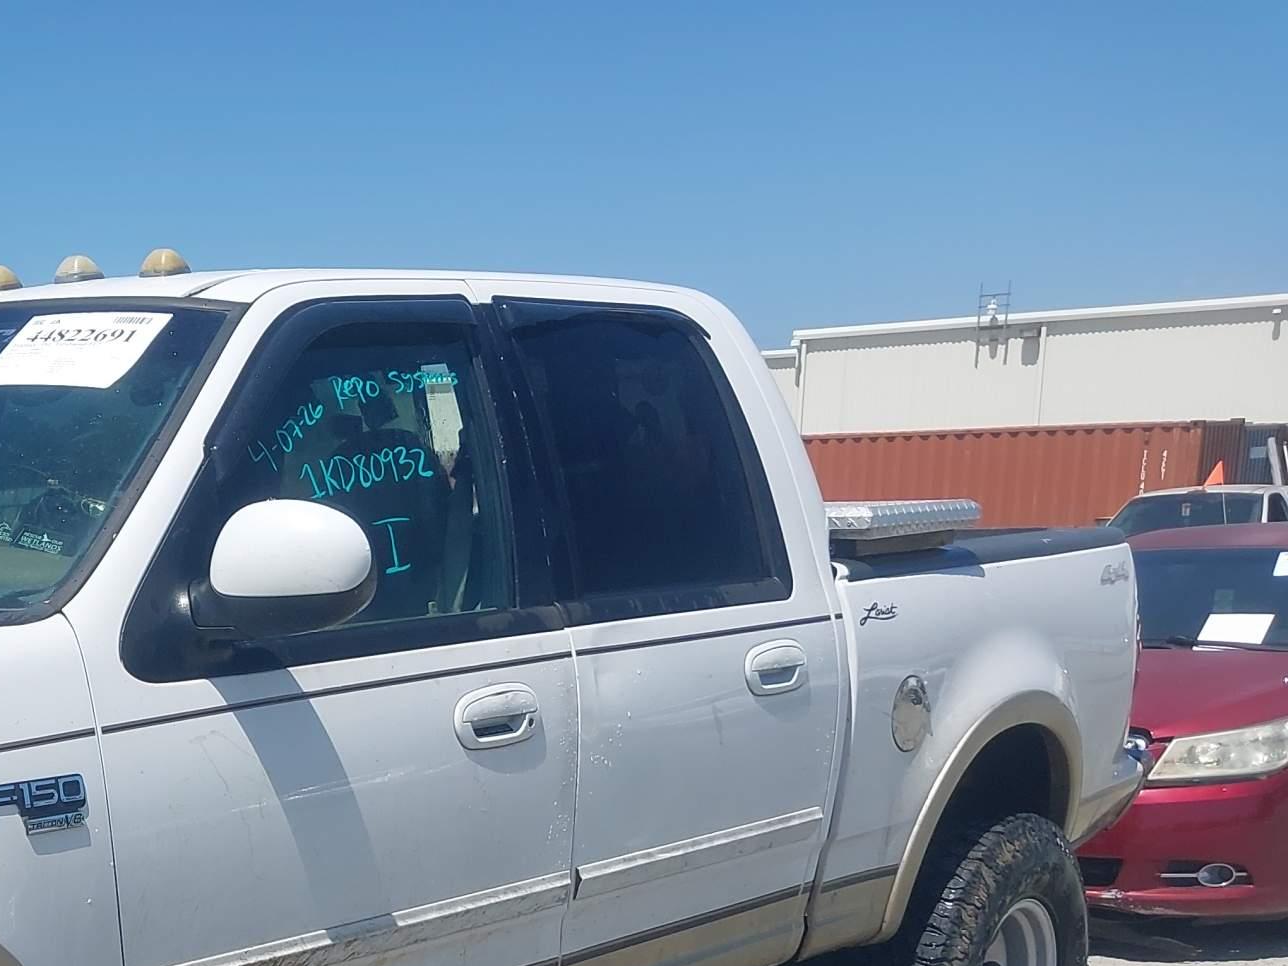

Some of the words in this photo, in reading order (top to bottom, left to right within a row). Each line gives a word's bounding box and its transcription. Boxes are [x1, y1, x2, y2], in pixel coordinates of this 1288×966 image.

[26, 328, 137, 343] 44822691
[859, 601, 898, 626] Lariat
[63, 813, 84, 829] V8
